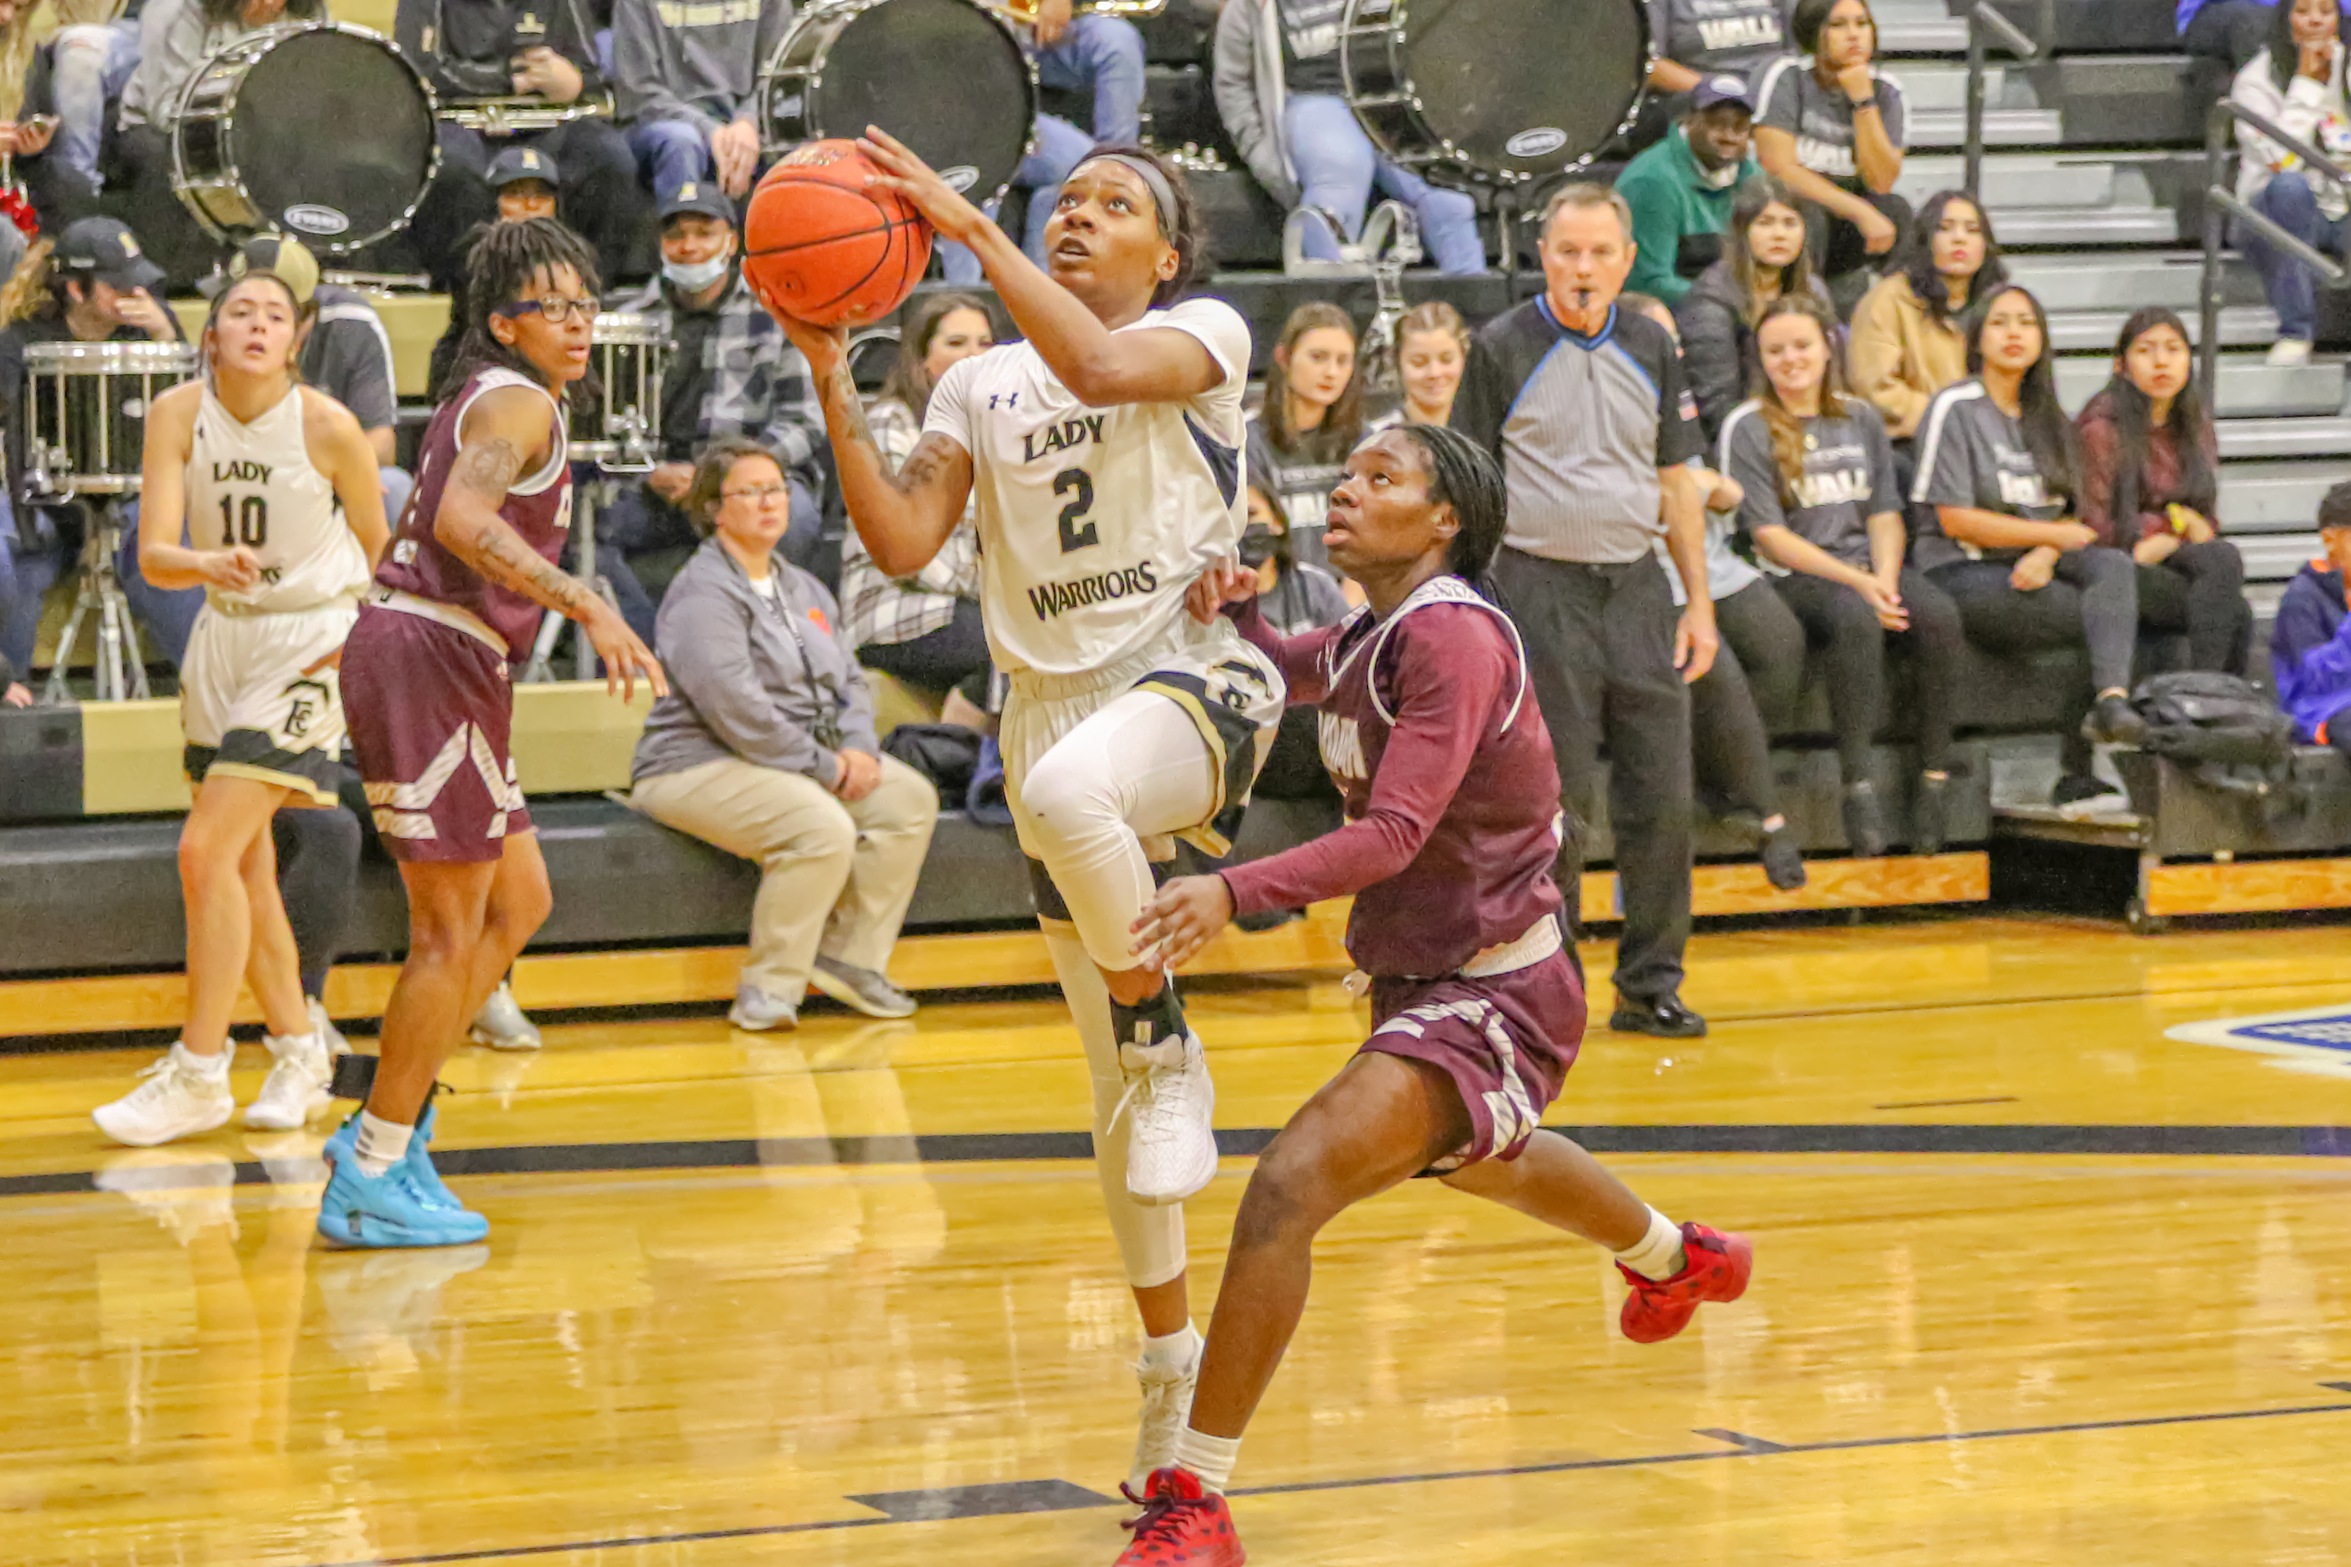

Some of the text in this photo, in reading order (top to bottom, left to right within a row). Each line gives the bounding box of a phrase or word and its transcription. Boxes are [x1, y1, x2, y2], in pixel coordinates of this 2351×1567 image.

[1022, 414, 1108, 464] LADY
[212, 460, 273, 485] LADY
[219, 493, 268, 549] 10
[1053, 467, 1099, 555] 2
[1027, 560, 1158, 622] WARRIORS
